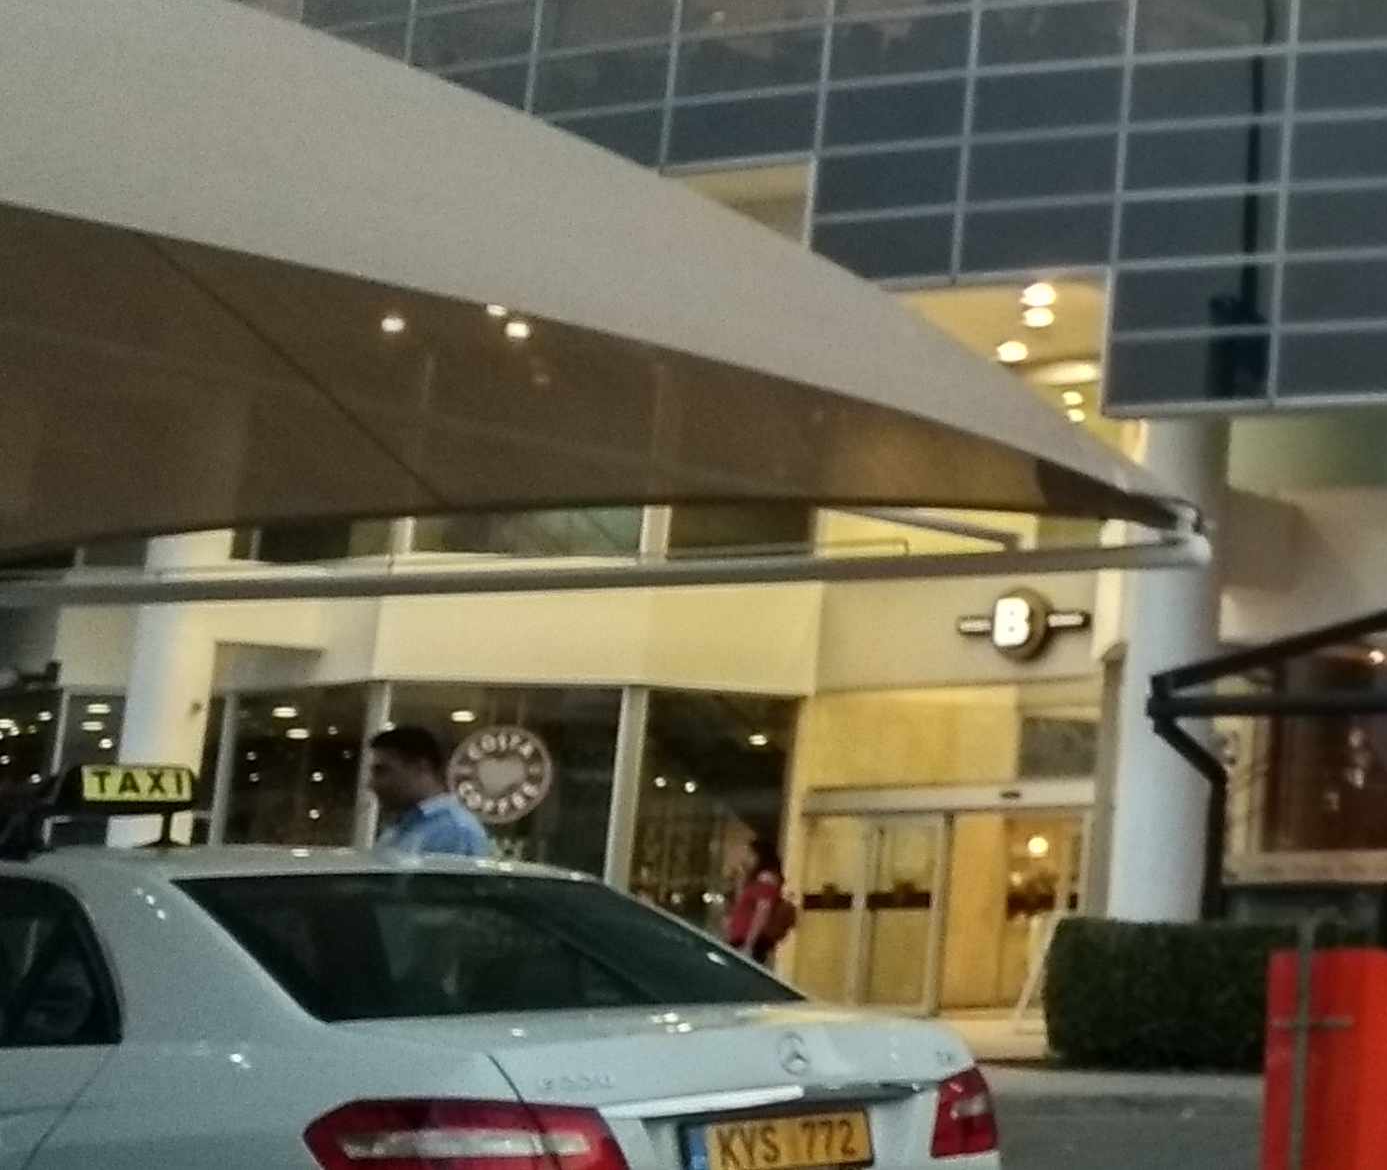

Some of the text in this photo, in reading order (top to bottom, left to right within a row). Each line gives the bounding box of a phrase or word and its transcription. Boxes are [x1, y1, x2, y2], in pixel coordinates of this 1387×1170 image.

[993, 597, 1030, 647] B
[467, 733, 534, 761] COSTA
[90, 770, 184, 795] TAXI
[458, 781, 539, 816] COFFEE
[716, 1119, 857, 1170] KYS 772
